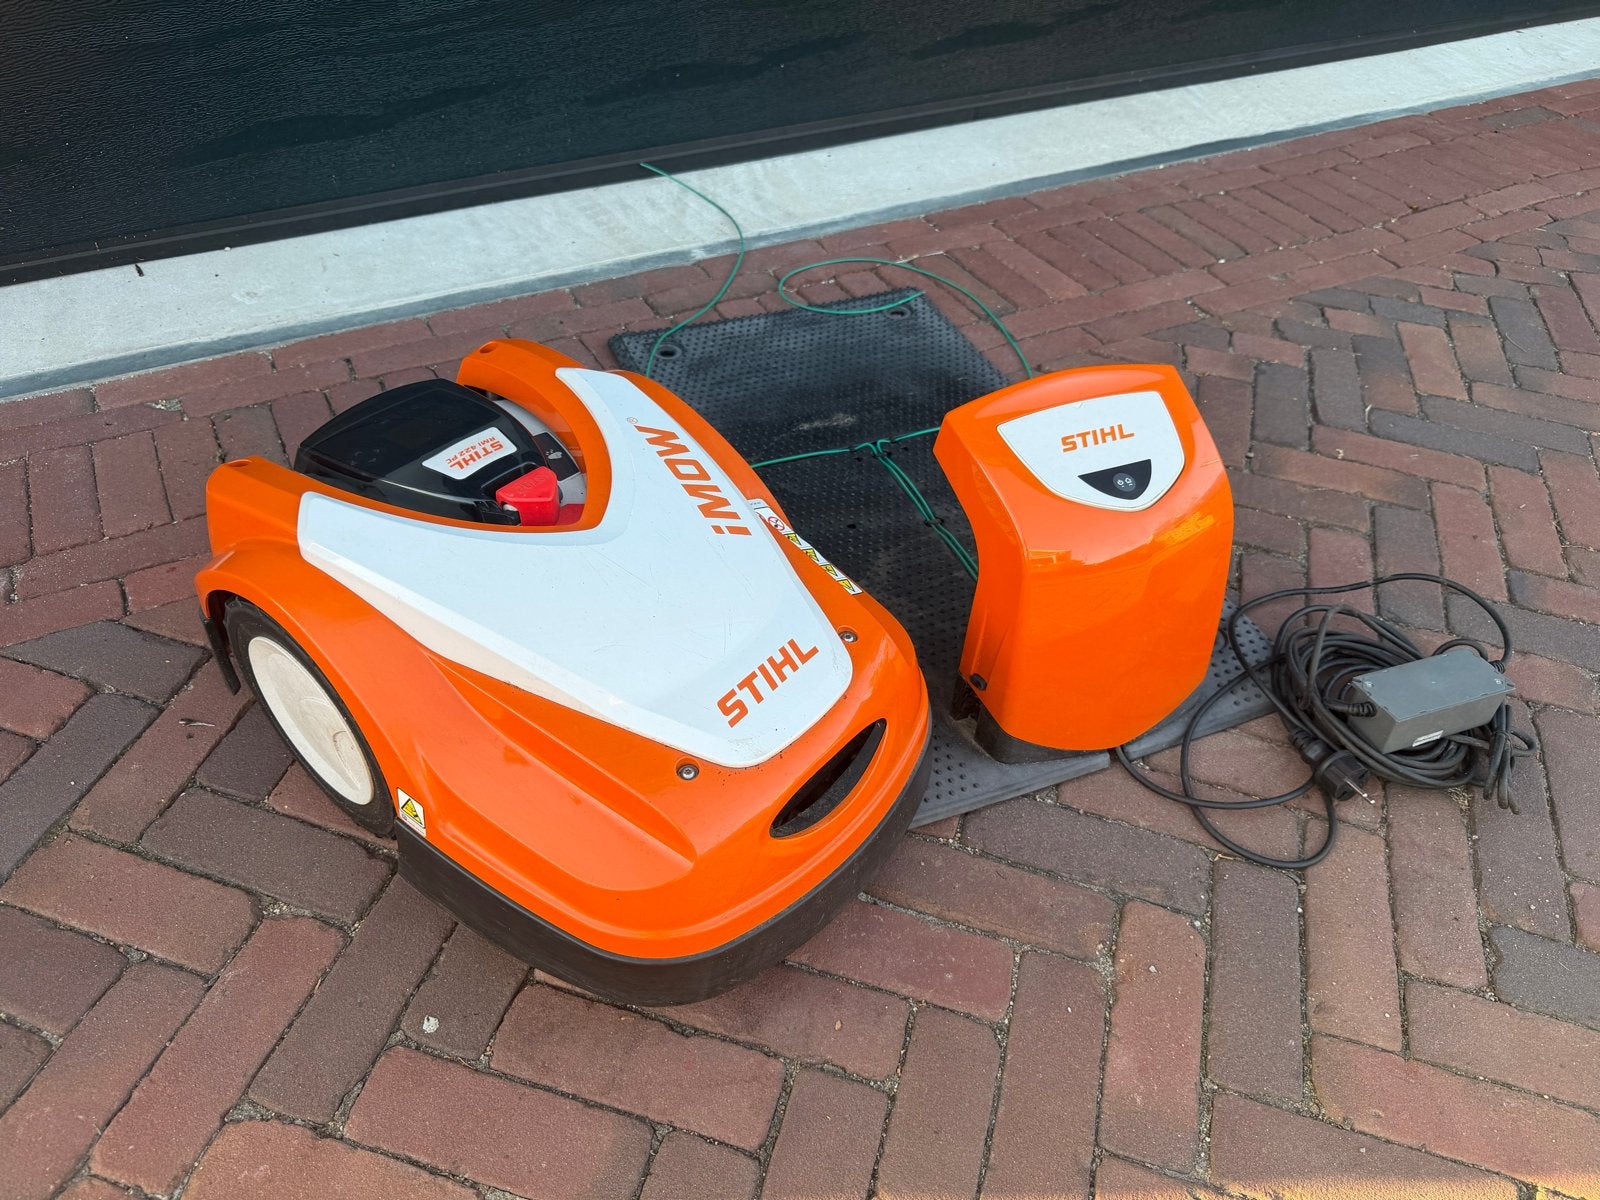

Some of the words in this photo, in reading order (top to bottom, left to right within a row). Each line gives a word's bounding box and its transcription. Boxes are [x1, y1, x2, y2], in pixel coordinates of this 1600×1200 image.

[457, 445, 477, 457] 422
[1060, 424, 1135, 453] STIHL
[449, 440, 504, 470] STIHL
[716, 638, 820, 728] STIHL
